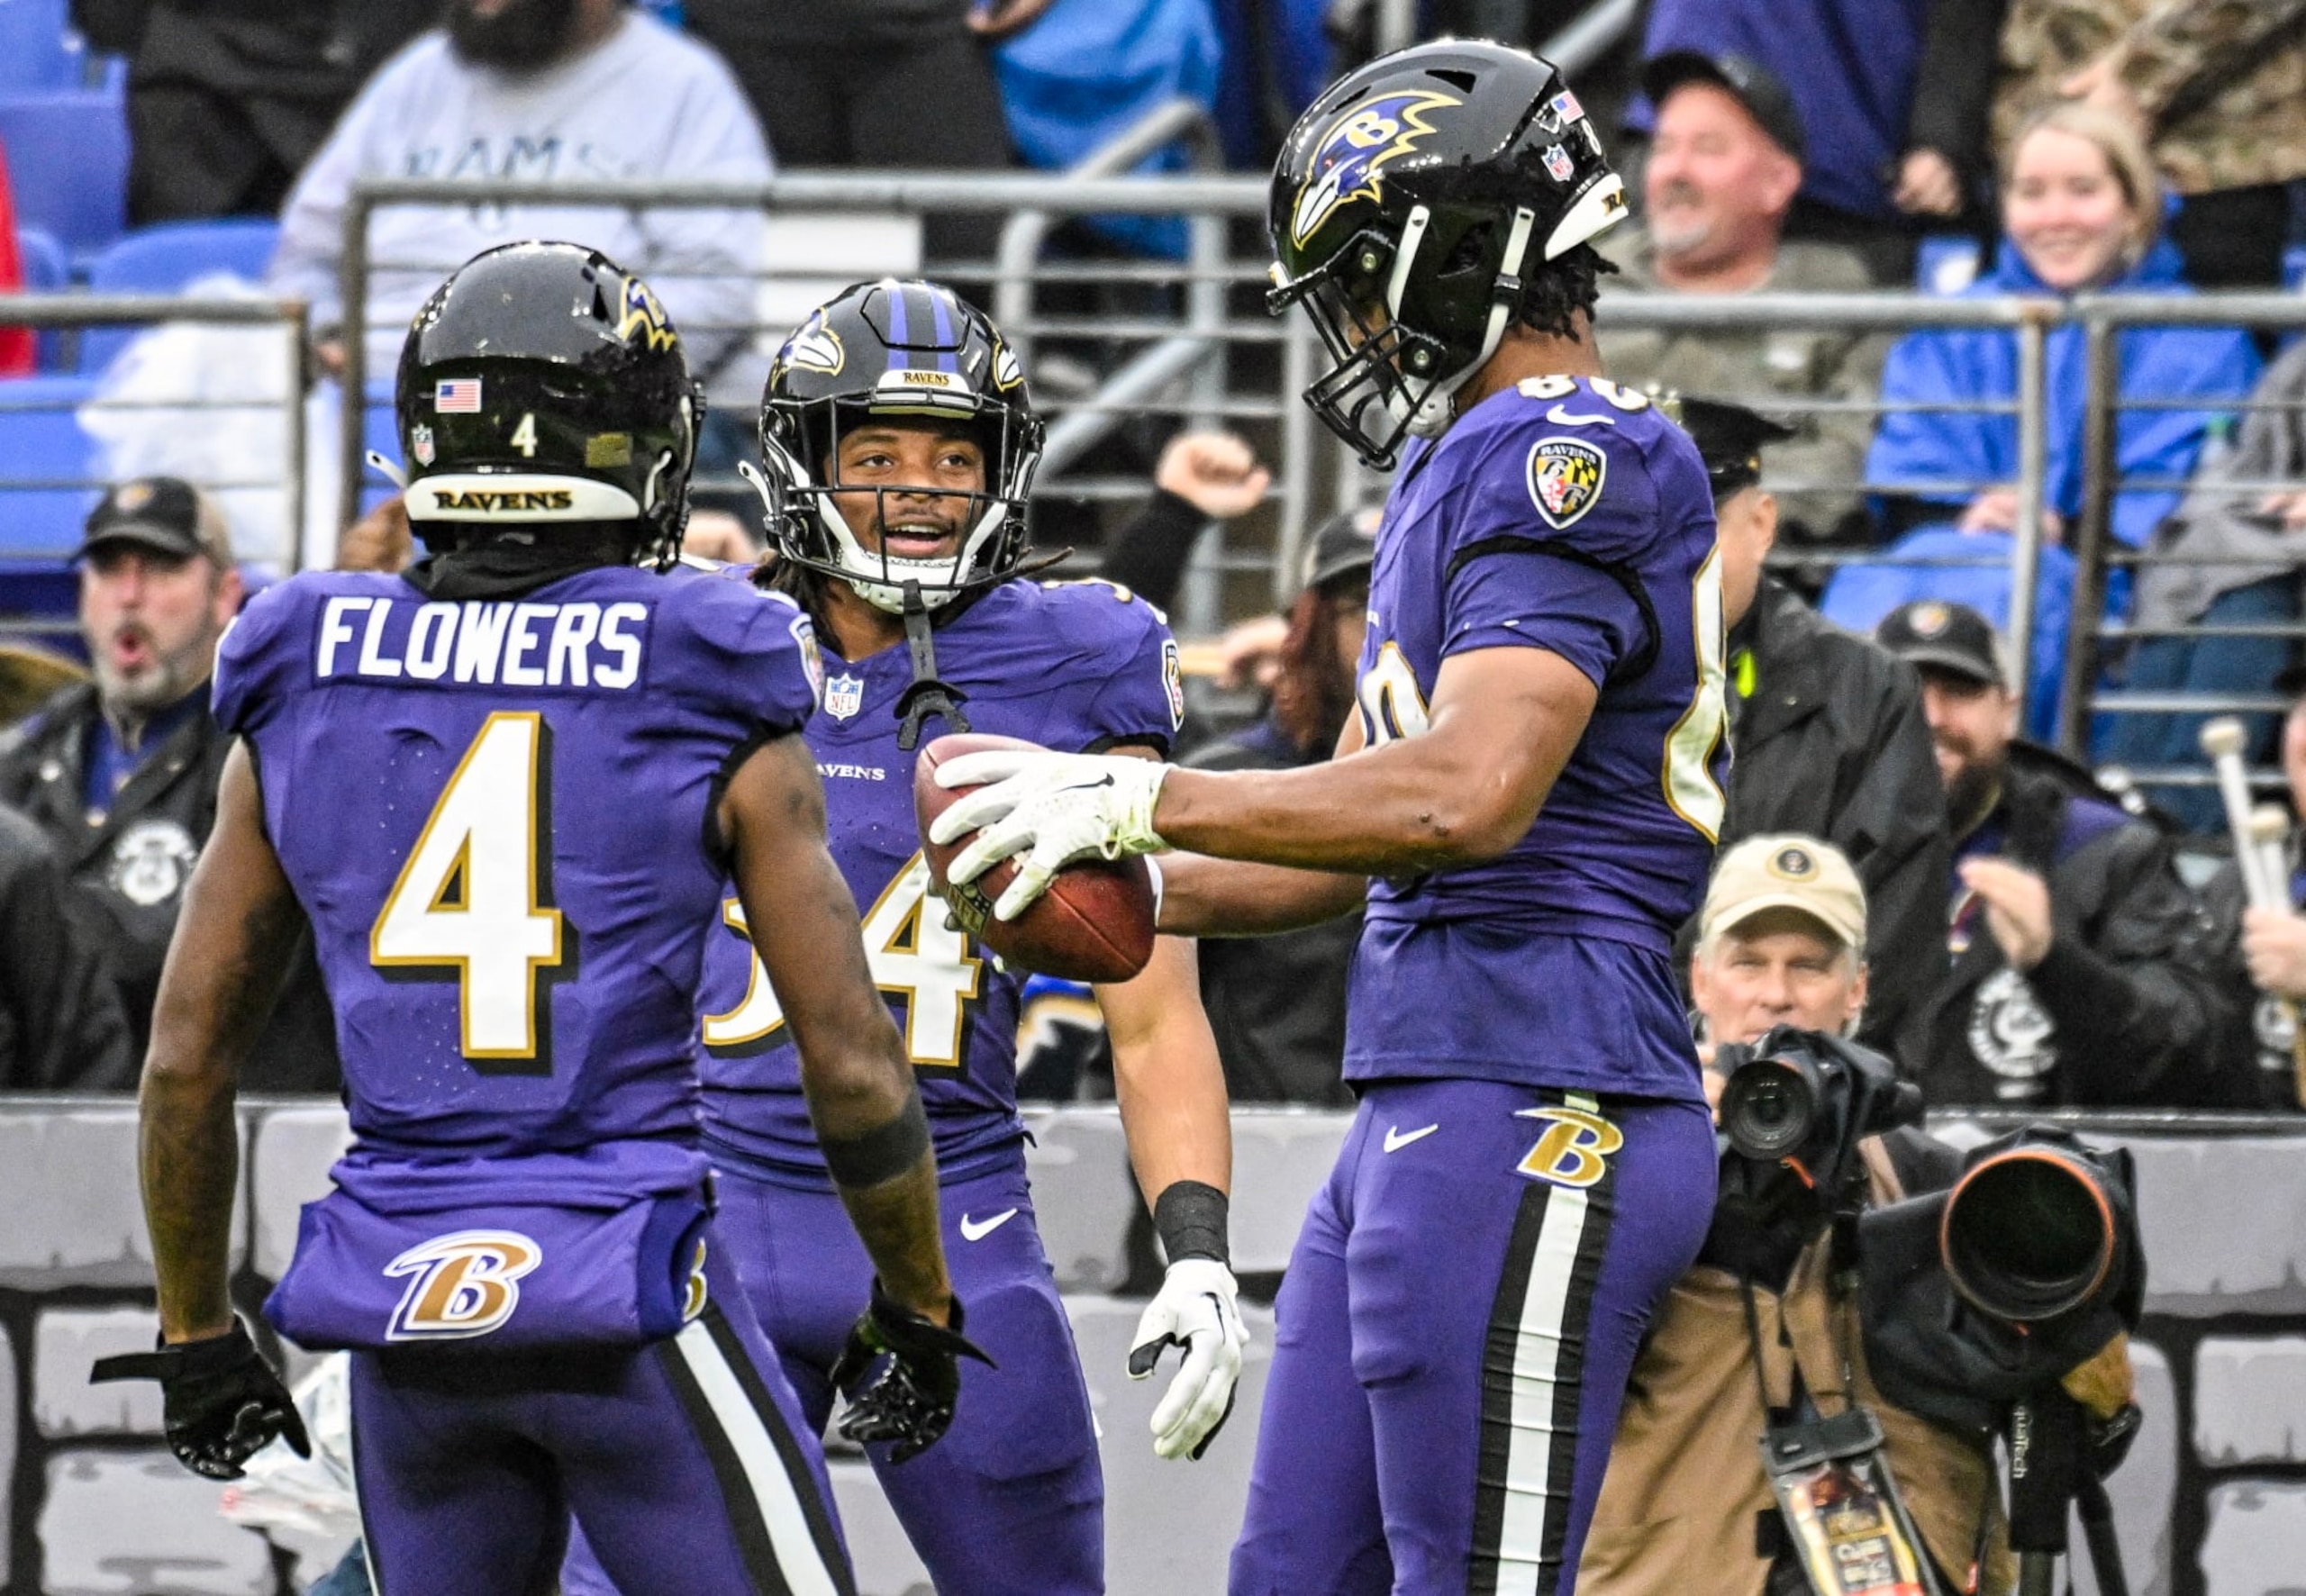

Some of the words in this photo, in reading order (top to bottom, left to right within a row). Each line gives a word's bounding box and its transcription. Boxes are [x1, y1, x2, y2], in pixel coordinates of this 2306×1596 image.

[903, 372, 949, 386] RAVENS
[511, 412, 538, 457] 4
[1539, 445, 1597, 465] RAVENS
[433, 490, 573, 512] RAVENS
[317, 596, 648, 690] FLOWERS
[831, 694, 855, 712] NFL
[816, 764, 885, 781] AVENS
[369, 711, 578, 1074] 4
[1512, 1107, 1624, 1187] B
[383, 1229, 542, 1341] B
